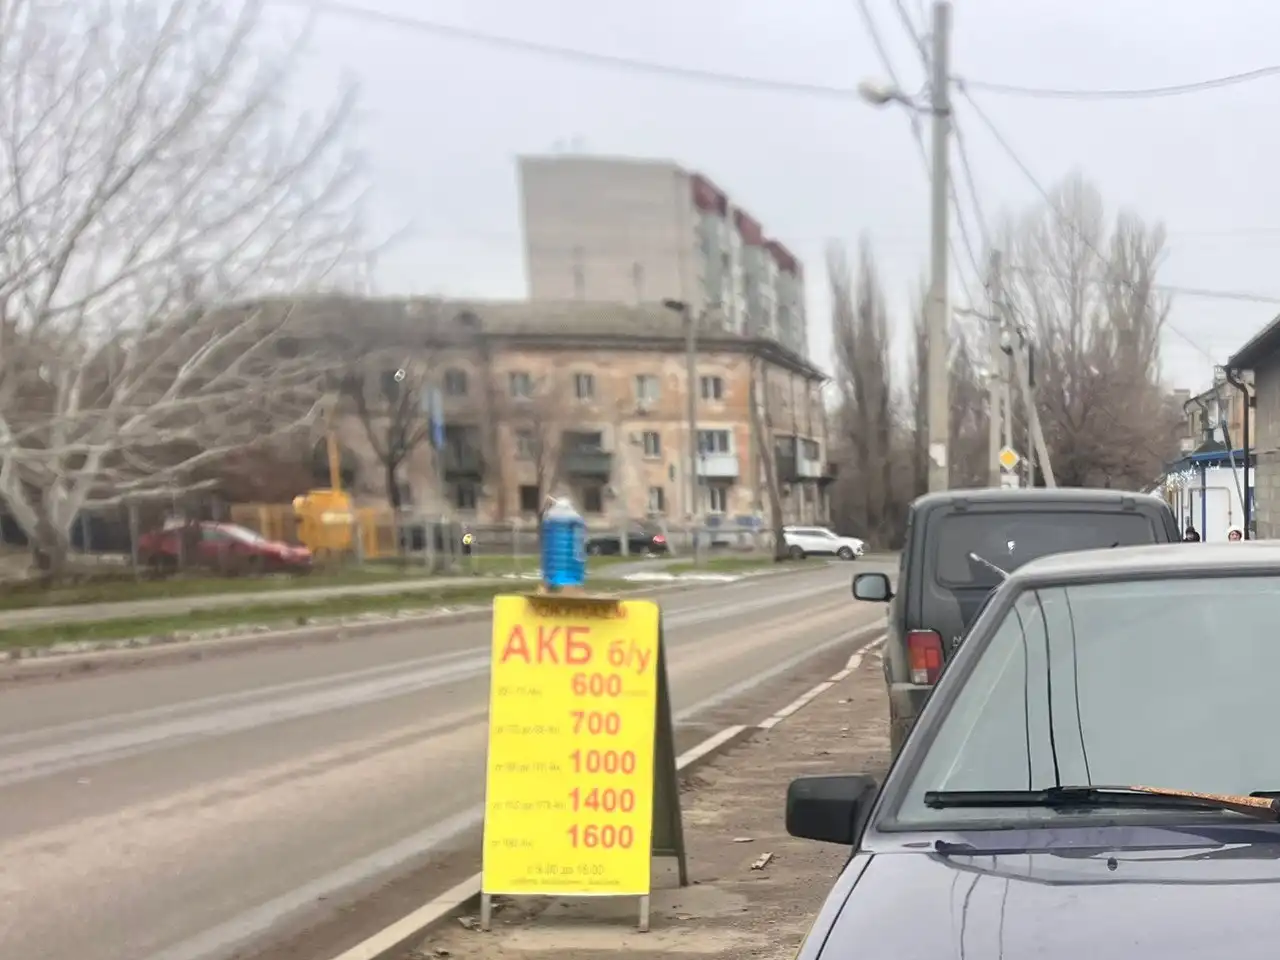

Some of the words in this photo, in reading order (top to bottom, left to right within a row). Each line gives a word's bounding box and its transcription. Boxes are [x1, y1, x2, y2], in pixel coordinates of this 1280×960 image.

[500, 624, 593, 665] АКБ
[608, 639, 652, 674] б/у
[571, 672, 622, 698] 600
[570, 711, 621, 736] 700
[569, 749, 637, 775] 1000
[568, 787, 636, 813] 1400
[567, 824, 634, 849] 1600
